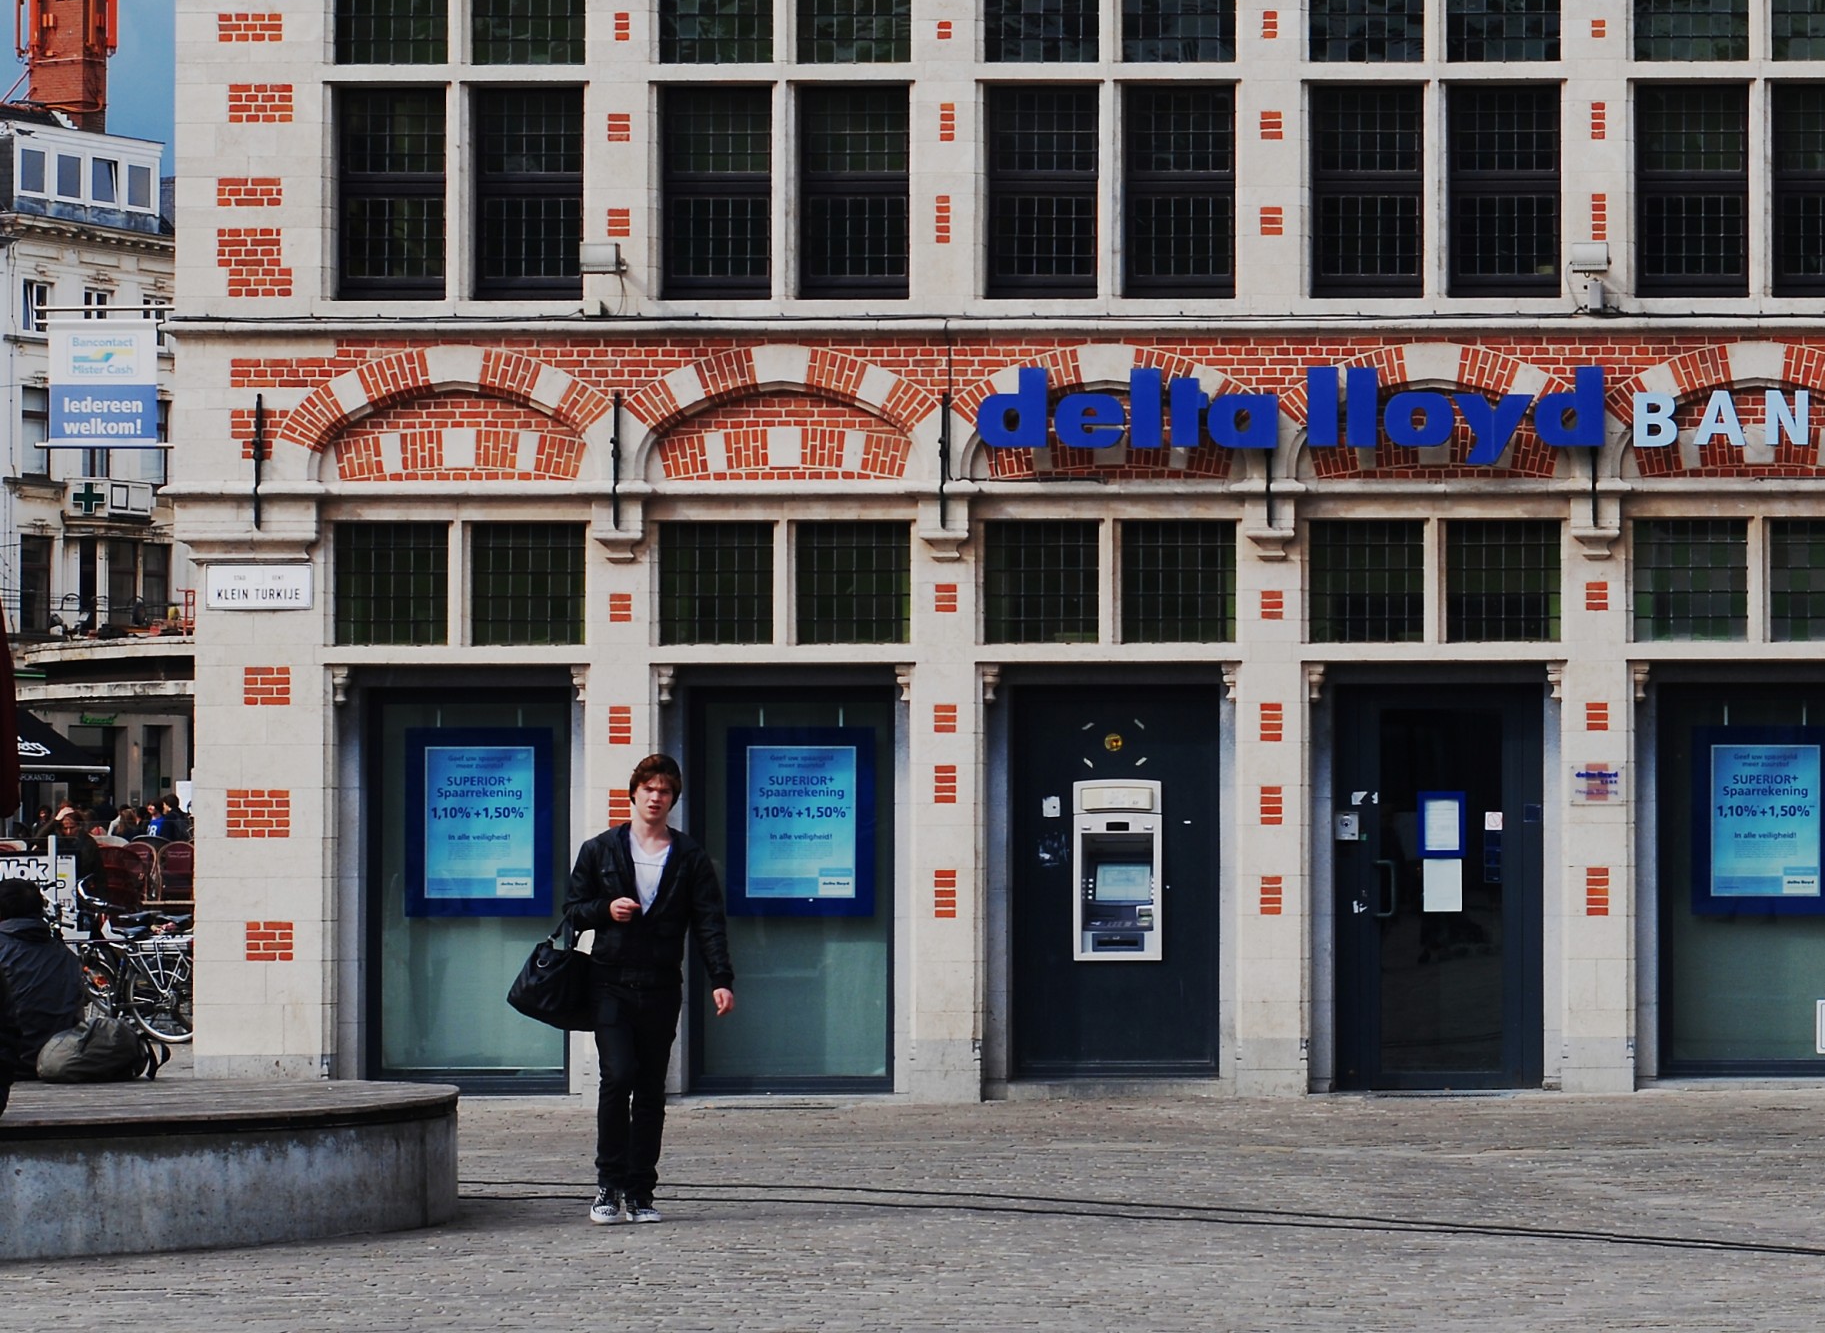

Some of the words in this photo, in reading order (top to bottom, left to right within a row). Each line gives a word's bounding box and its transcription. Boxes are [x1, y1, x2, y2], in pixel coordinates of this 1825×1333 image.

[72, 337, 133, 347] Bancontact
[72, 365, 104, 374] Mister
[107, 365, 133, 374] Cash
[63, 396, 143, 413] Iedereen
[977, 367, 1278, 448] delta
[1307, 366, 1605, 464] lloyd
[63, 418, 142, 435] welkom!
[217, 588, 249, 600] KLEIN
[255, 588, 300, 600] TURKIJE
[447, 776, 512, 786] SUPERIOR+
[769, 775, 834, 786] SUPERIOR+
[1733, 774, 1799, 784] SUPERIOR+
[437, 788, 522, 800] Spaarrekening
[759, 787, 845, 800] Spaarrekening
[1723, 786, 1808, 798] Spaarrekening
[794, 833, 832, 841] veiligheid!
[1758, 832, 1796, 840] veiligheid!
[0, 858, 49, 881] Wok
